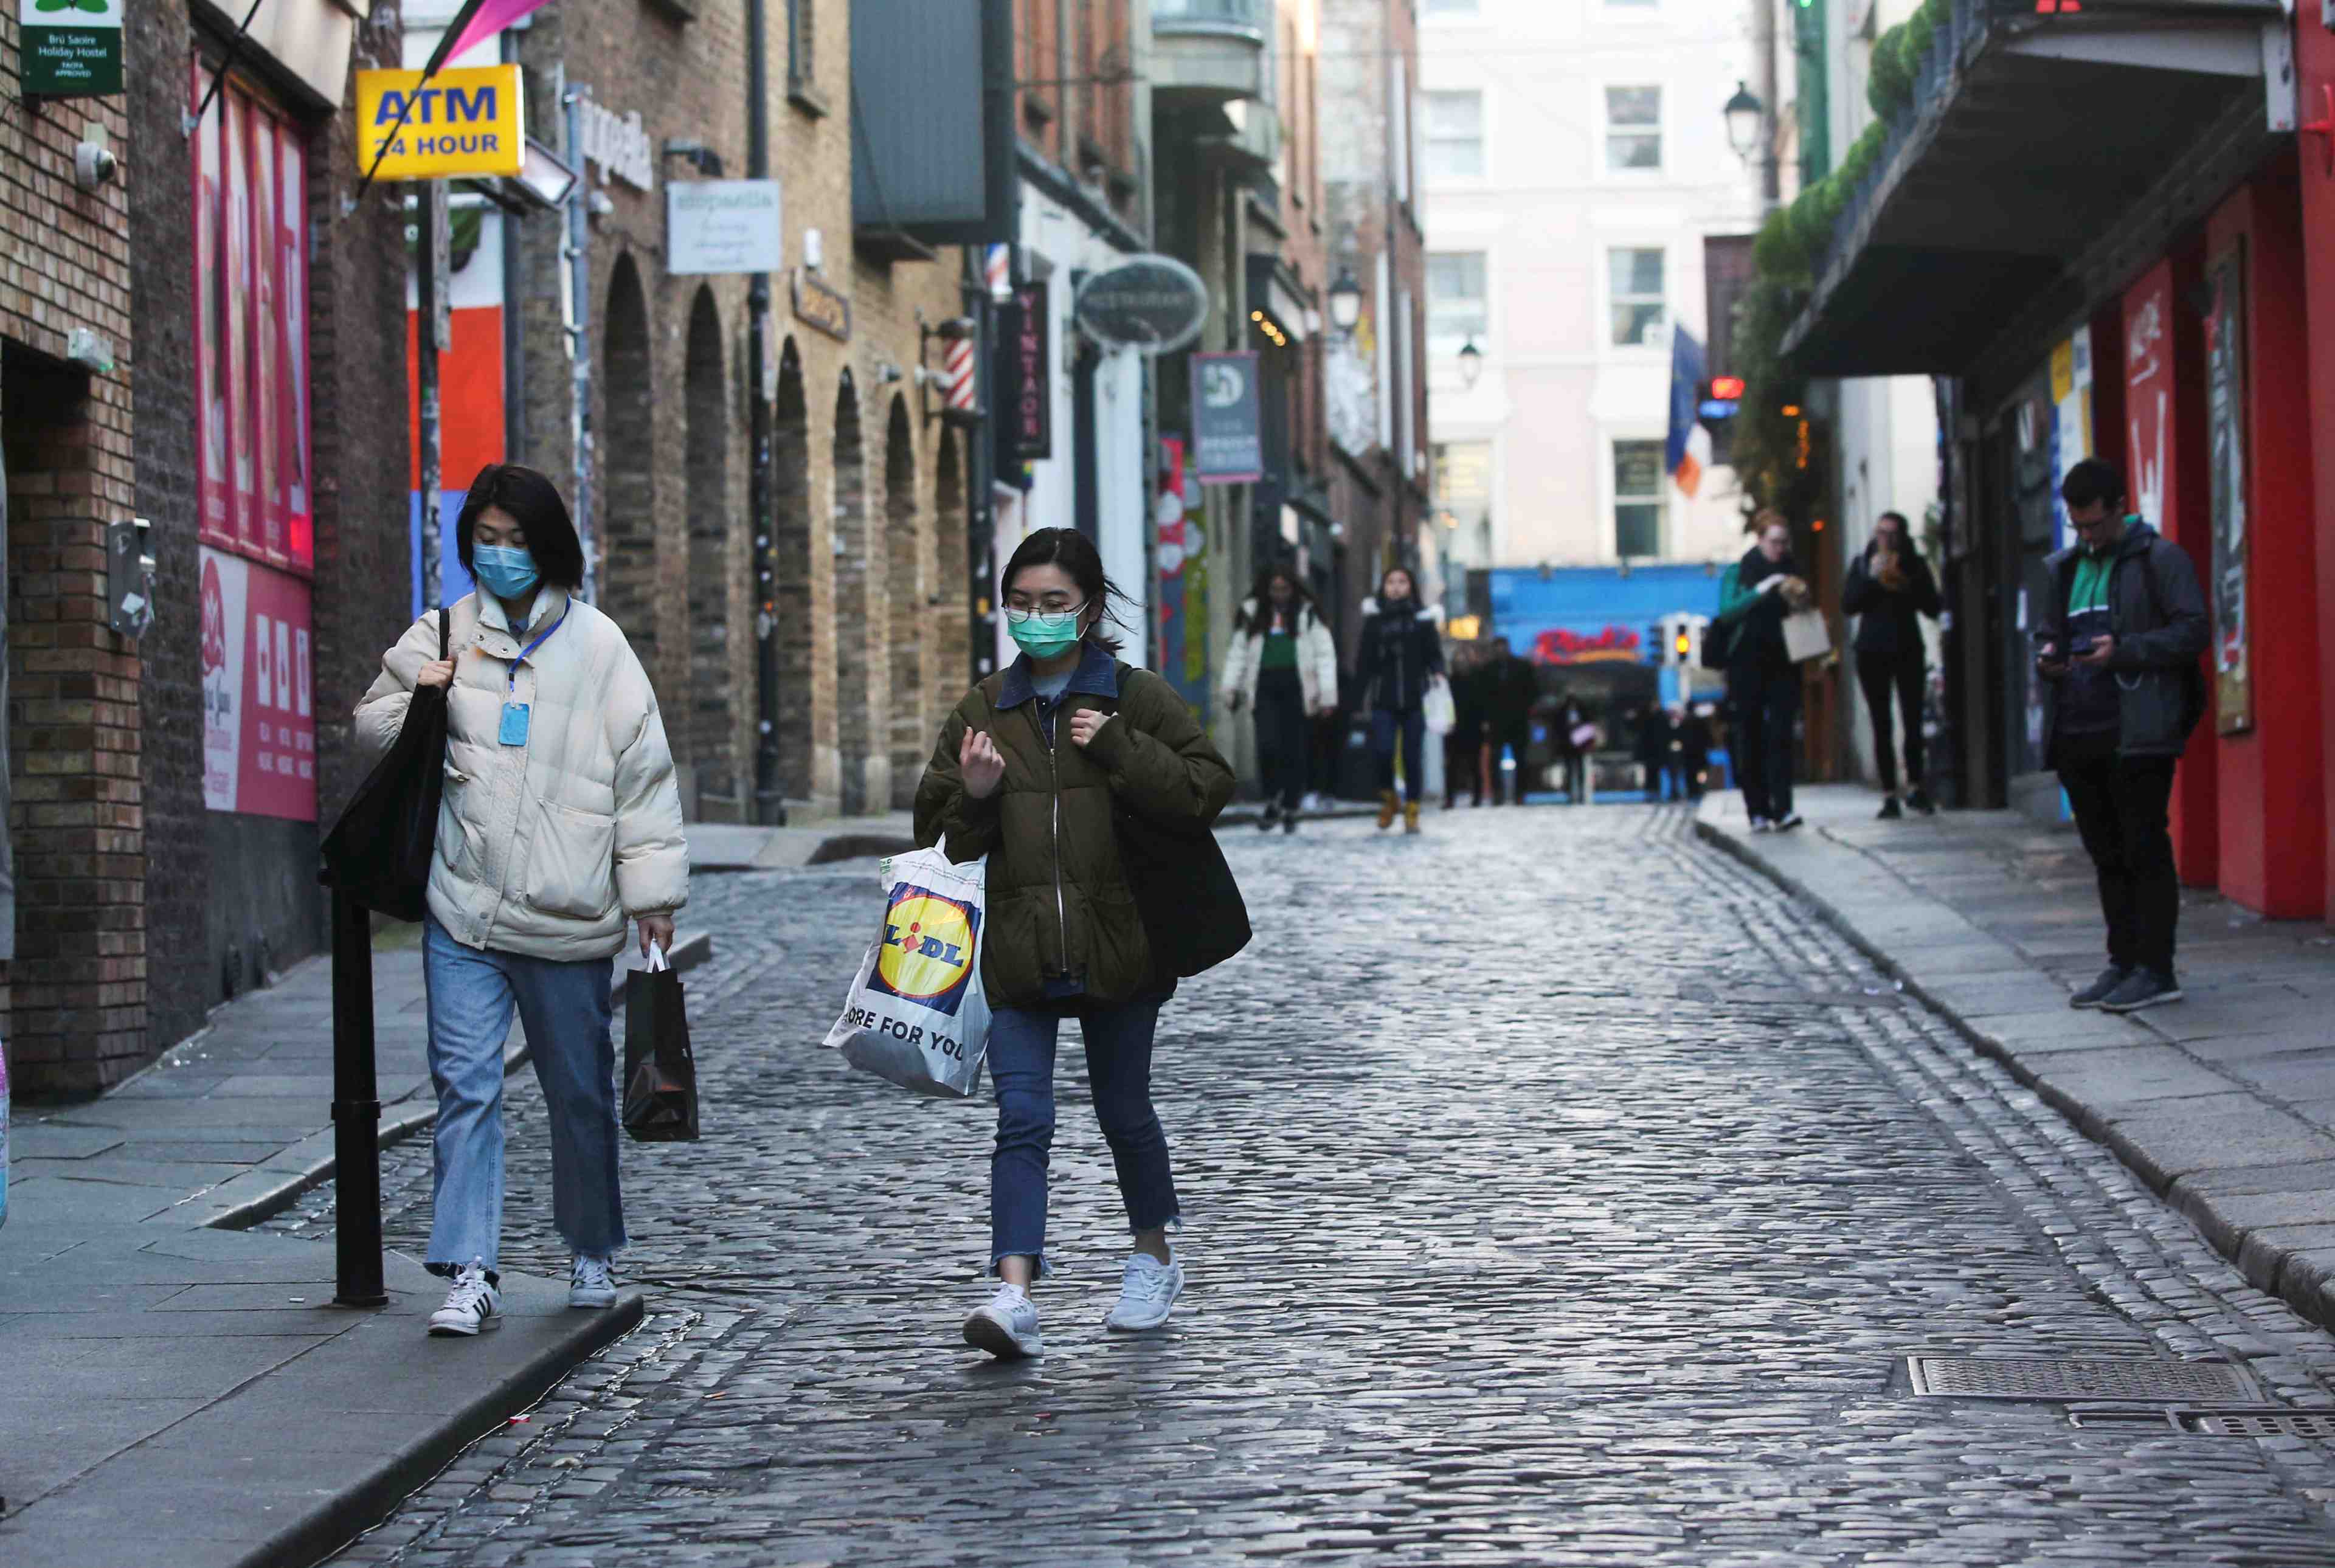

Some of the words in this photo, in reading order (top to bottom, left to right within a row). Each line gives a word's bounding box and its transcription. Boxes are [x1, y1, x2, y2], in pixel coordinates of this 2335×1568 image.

[38, 46, 73, 59] Holiday
[77, 47, 106, 57] Hostel
[374, 86, 497, 125] ATM
[375, 138, 406, 157] 24
[417, 134, 498, 154] HOUR
[1019, 292, 1040, 437] VINTAGE
[879, 1016, 924, 1045] FOR
